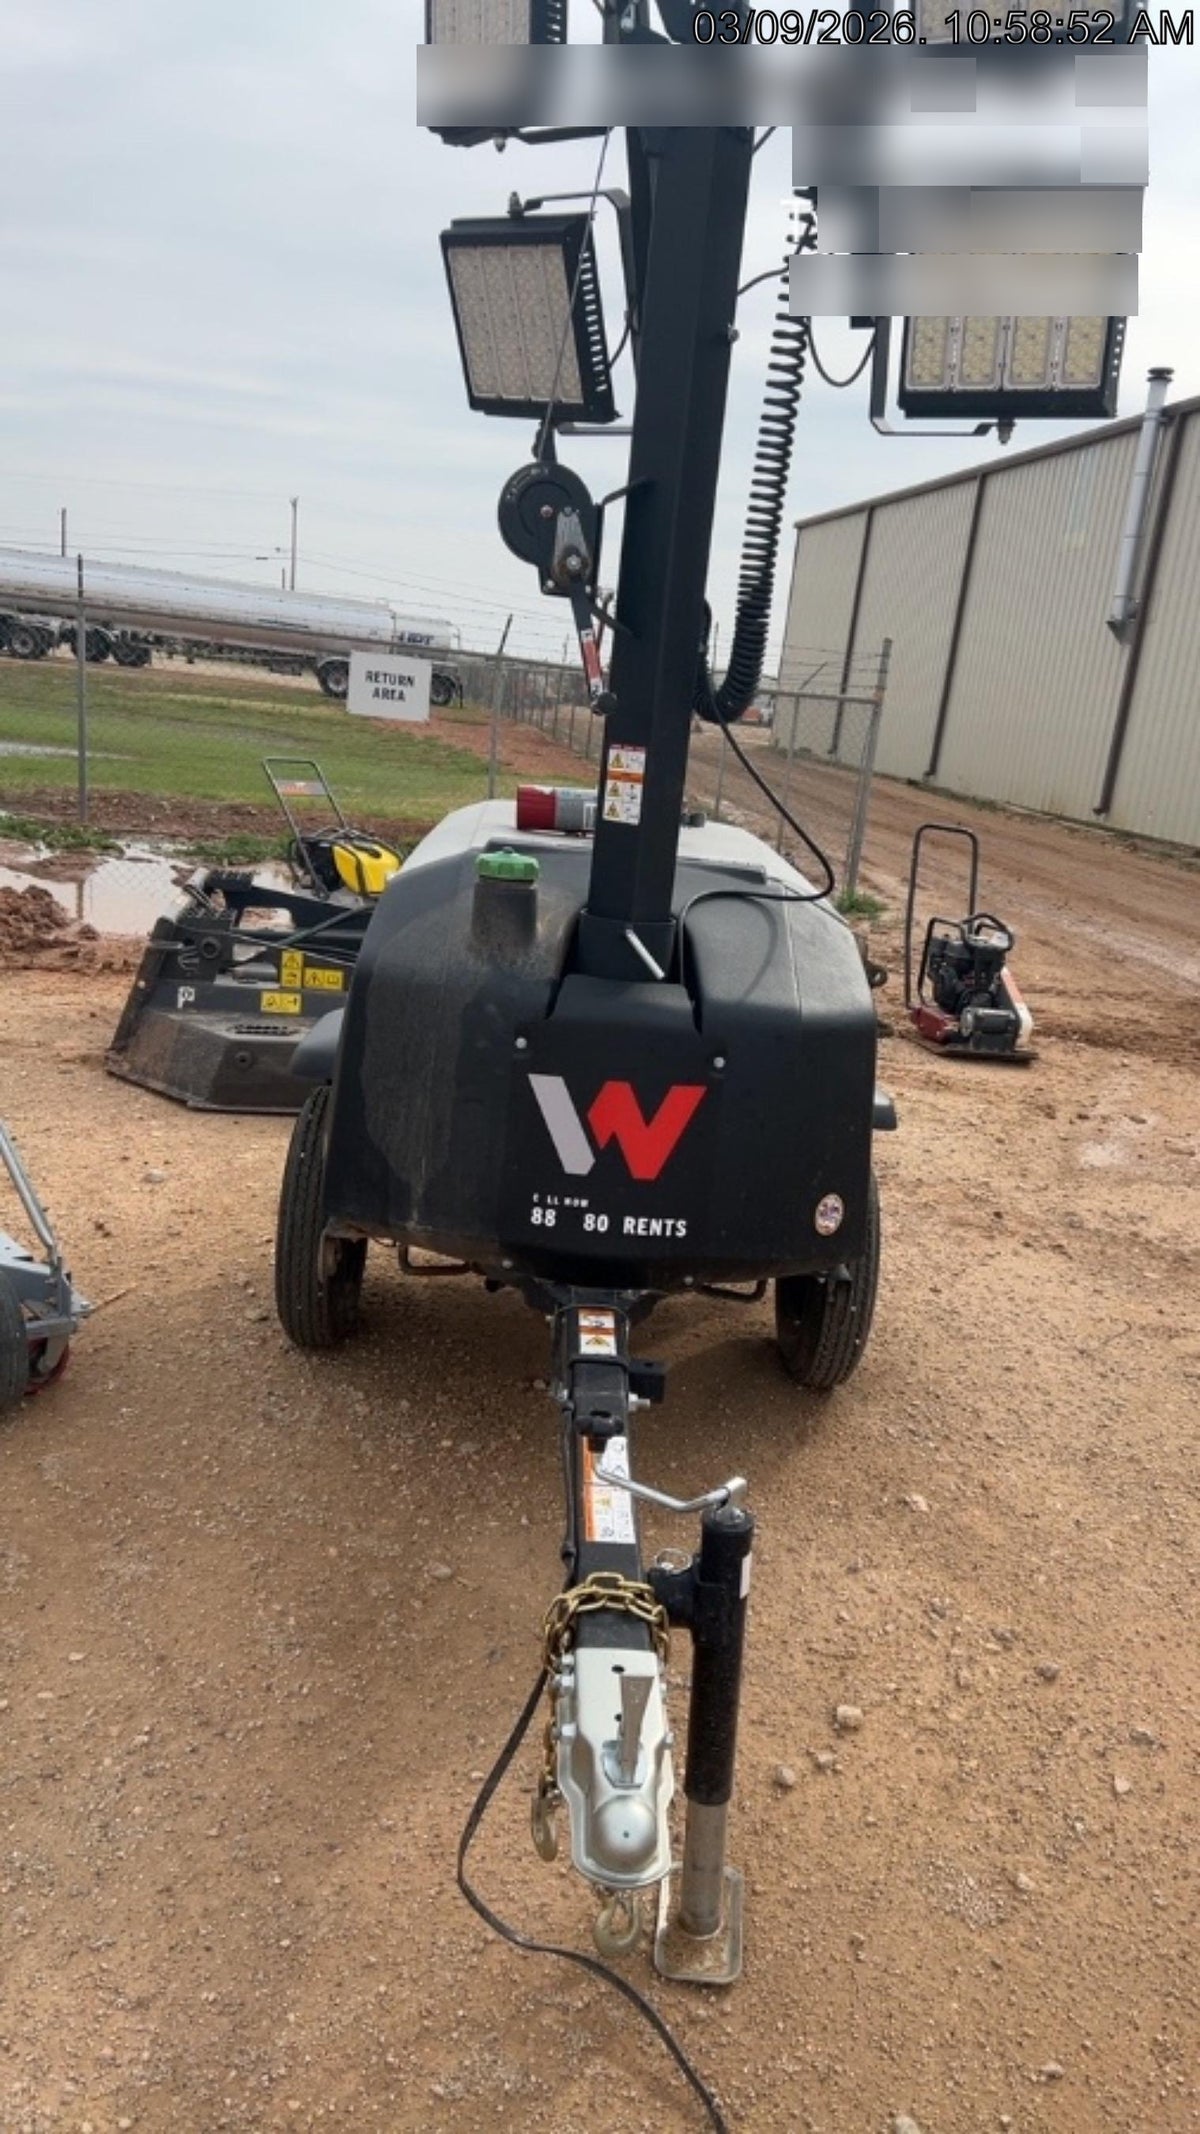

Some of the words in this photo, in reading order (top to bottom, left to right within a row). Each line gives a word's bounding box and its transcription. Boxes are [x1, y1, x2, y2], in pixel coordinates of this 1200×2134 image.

[365, 671, 414, 686] RETURN
[373, 687, 405, 701] AREA
[623, 1216, 687, 1238] RENTS
